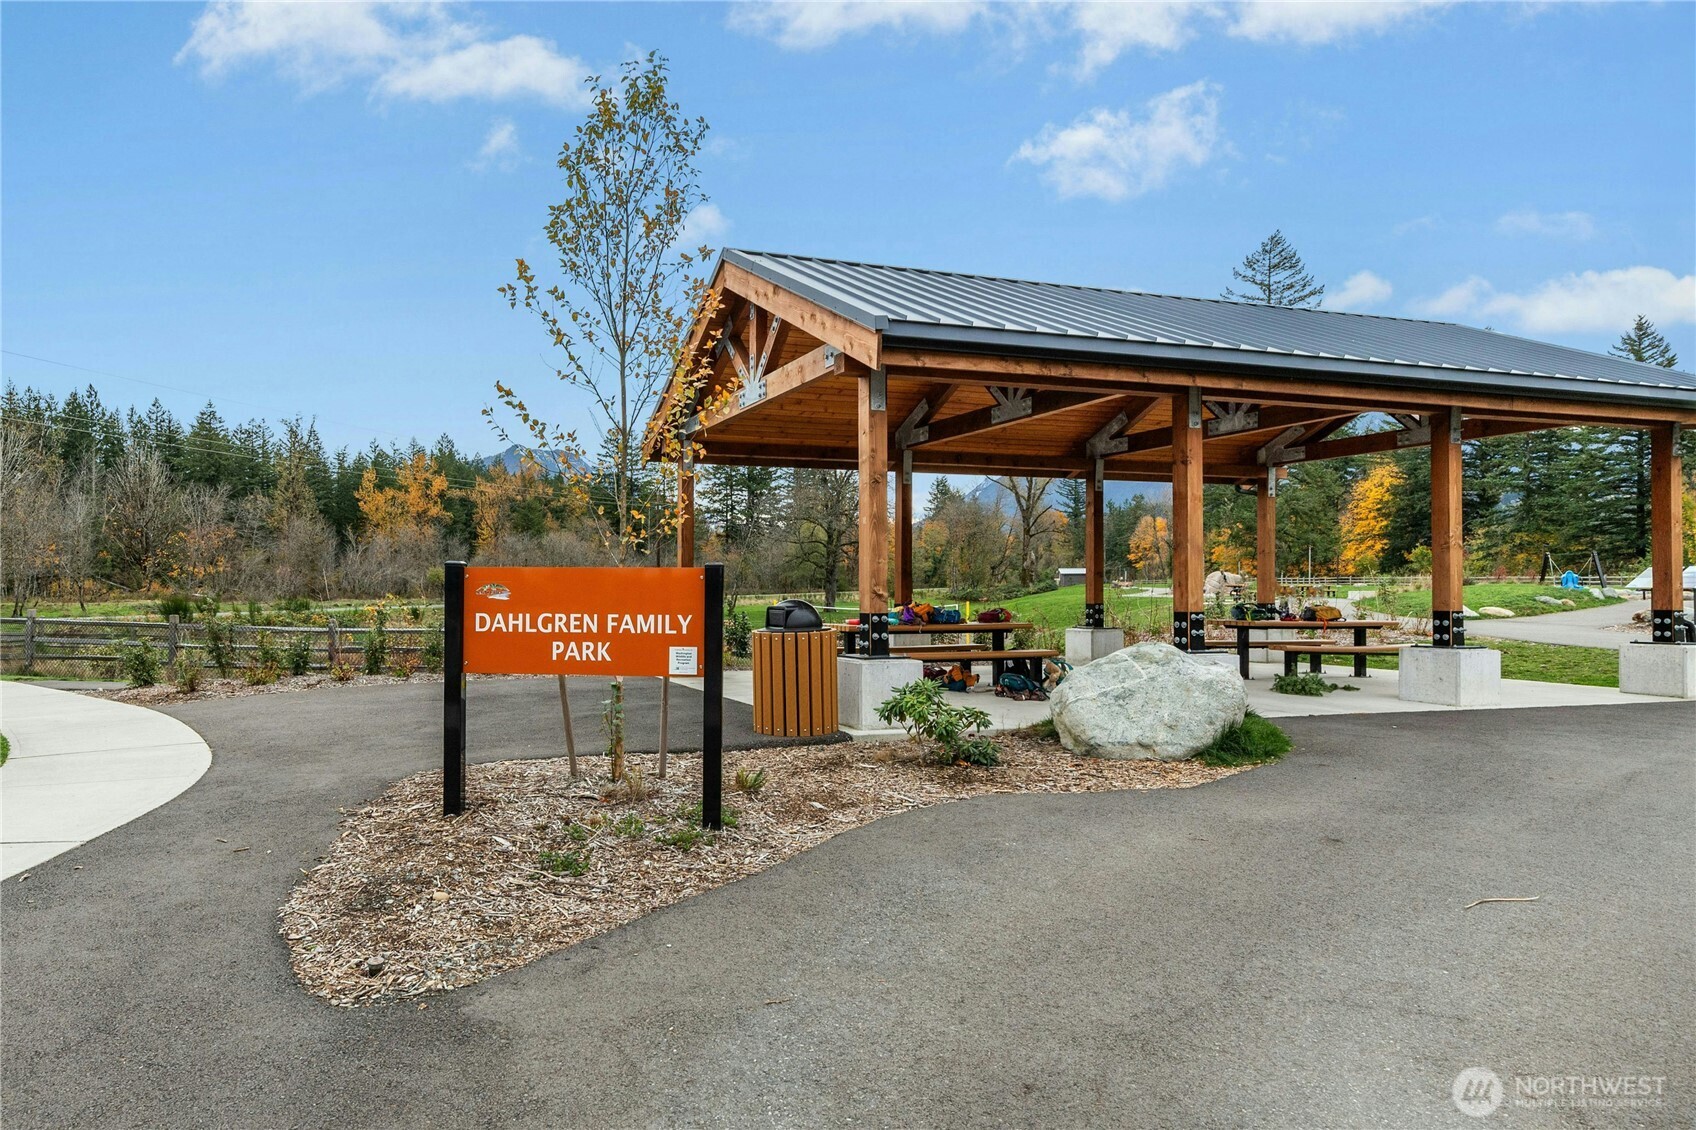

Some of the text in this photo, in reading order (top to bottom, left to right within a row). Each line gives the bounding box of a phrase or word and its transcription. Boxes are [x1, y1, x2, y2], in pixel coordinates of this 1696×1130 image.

[475, 612, 693, 635] DAHLGREN FAMILY
[552, 641, 612, 662] PARK
